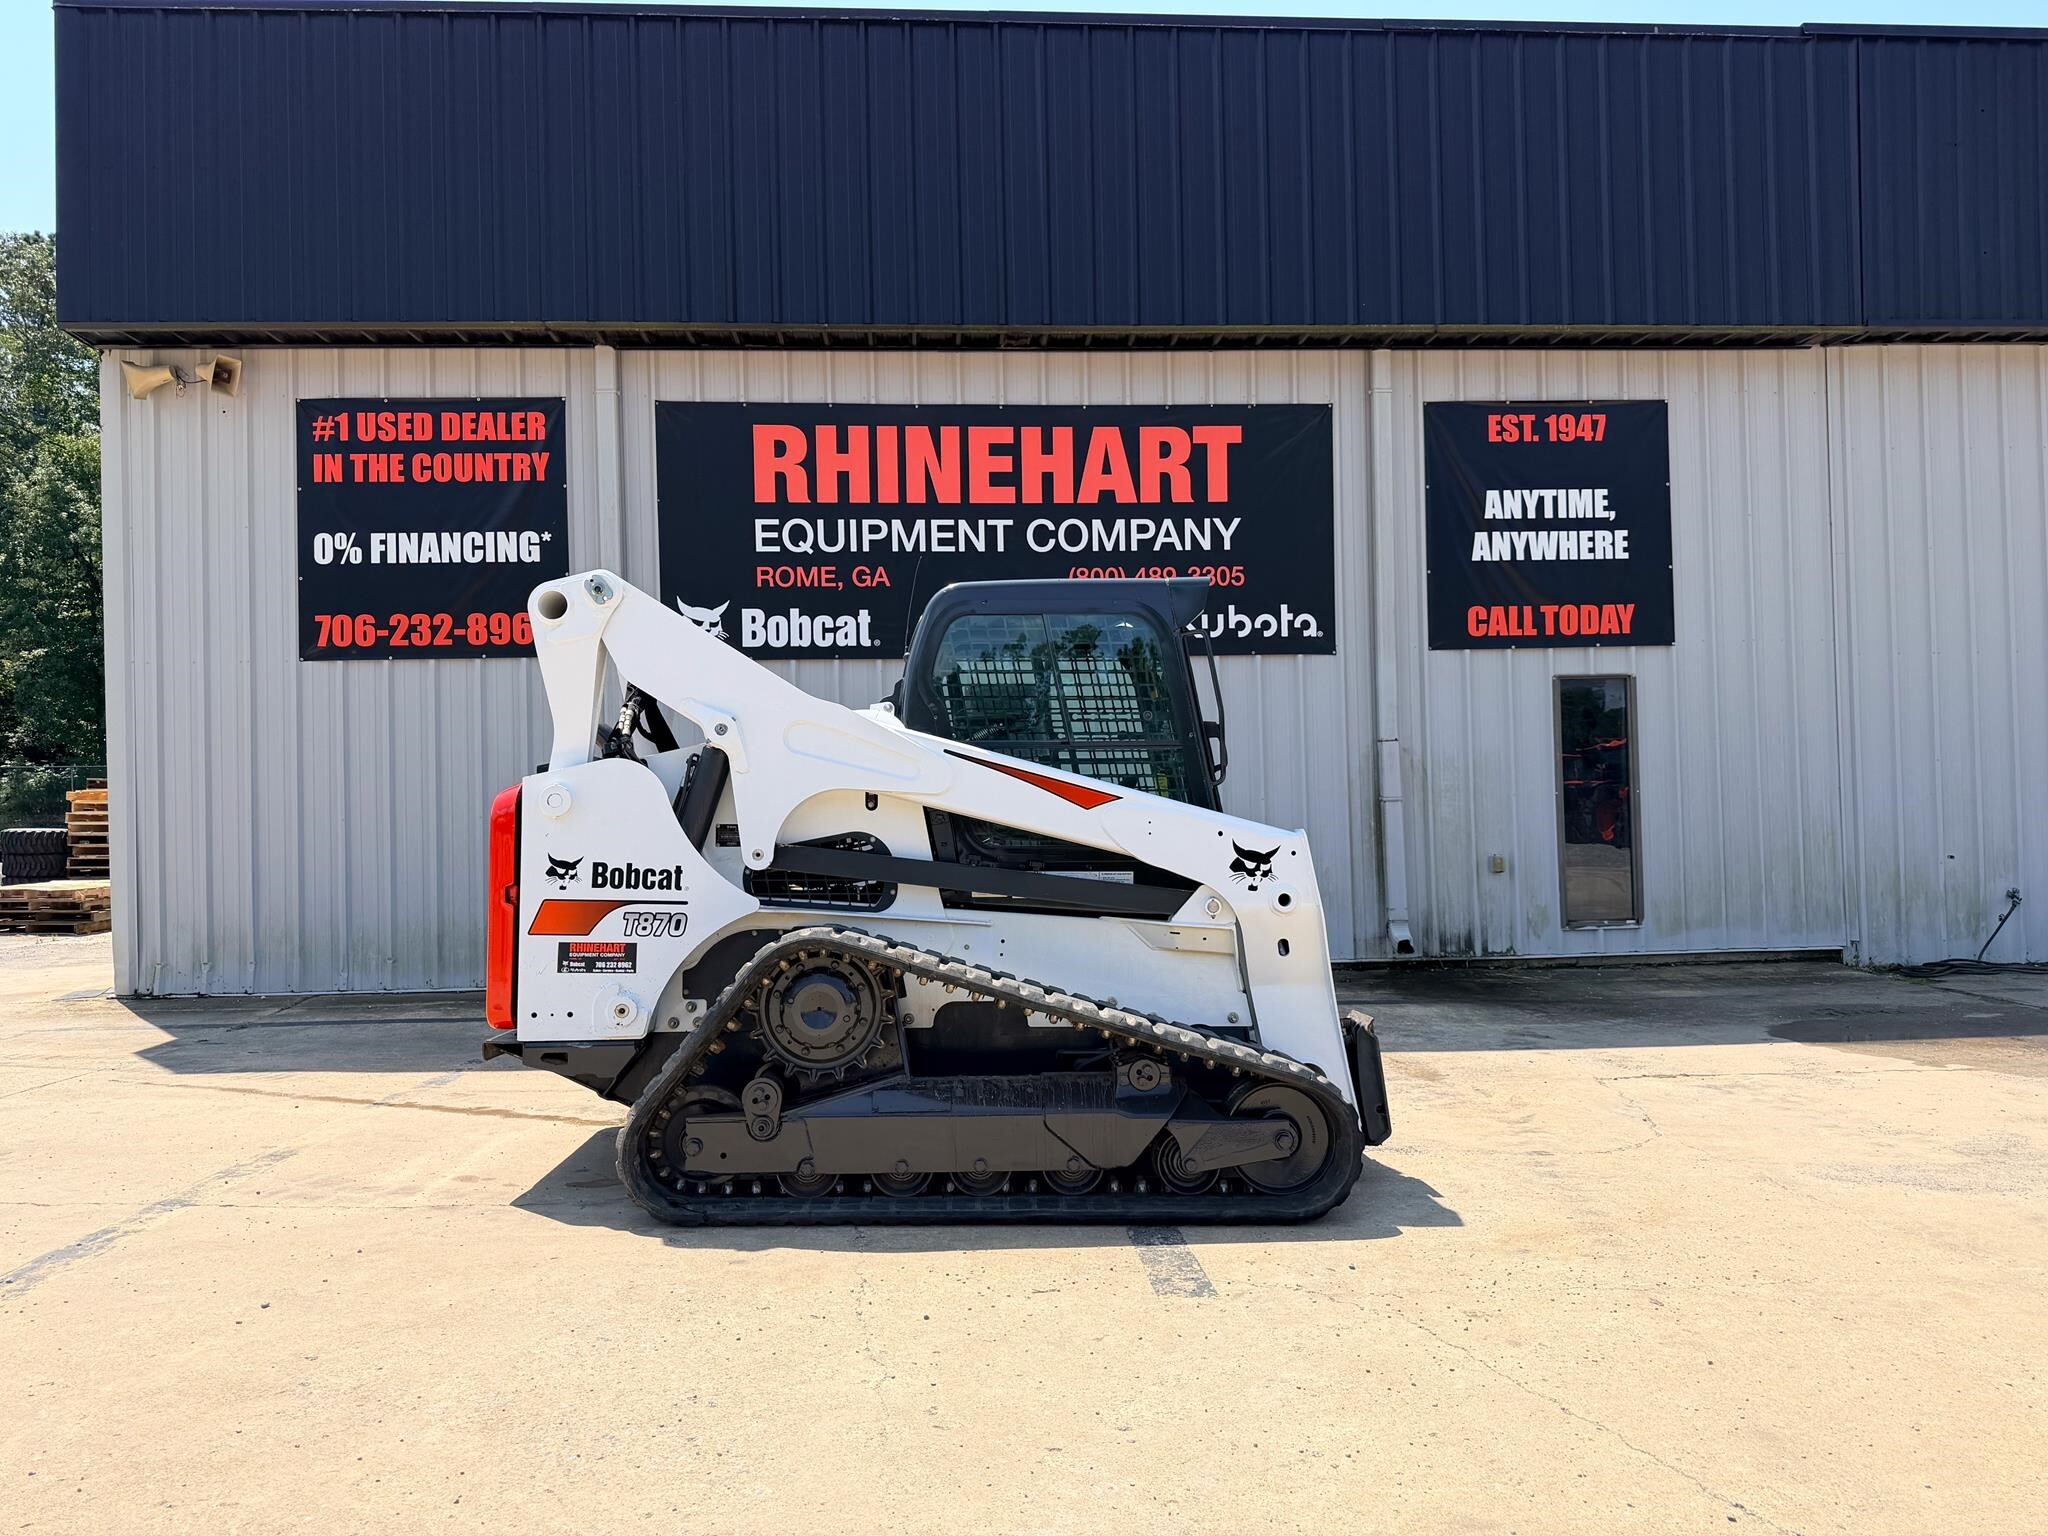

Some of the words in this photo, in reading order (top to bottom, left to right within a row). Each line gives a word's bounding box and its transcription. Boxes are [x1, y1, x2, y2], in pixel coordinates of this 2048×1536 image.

[312, 412, 349, 442] #1
[356, 412, 433, 442] USED
[441, 411, 546, 441] DEALER
[1487, 414, 1539, 442] EST.
[1544, 413, 1606, 442] 1947
[313, 453, 343, 483] IN
[350, 453, 404, 483] THE
[411, 451, 550, 483] COUNTRY
[752, 423, 1243, 504] RHINEHART
[1484, 488, 1616, 521] ANYTIME,
[313, 532, 363, 565] 0%
[754, 517, 1014, 555] EQUIPMENT
[1025, 517, 1242, 553] COMPANY
[1471, 529, 1630, 562] ANYWHERE
[756, 566, 843, 591] ROME,
[851, 566, 891, 588] GA
[314, 612, 535, 647] 706-232-896
[741, 607, 872, 648] Bobcat
[1467, 605, 1538, 637] CALL
[1540, 603, 1636, 636] TODAY
[591, 861, 684, 891] Bobcat
[623, 911, 688, 938] T870
[569, 943, 626, 952] RHINEHART
